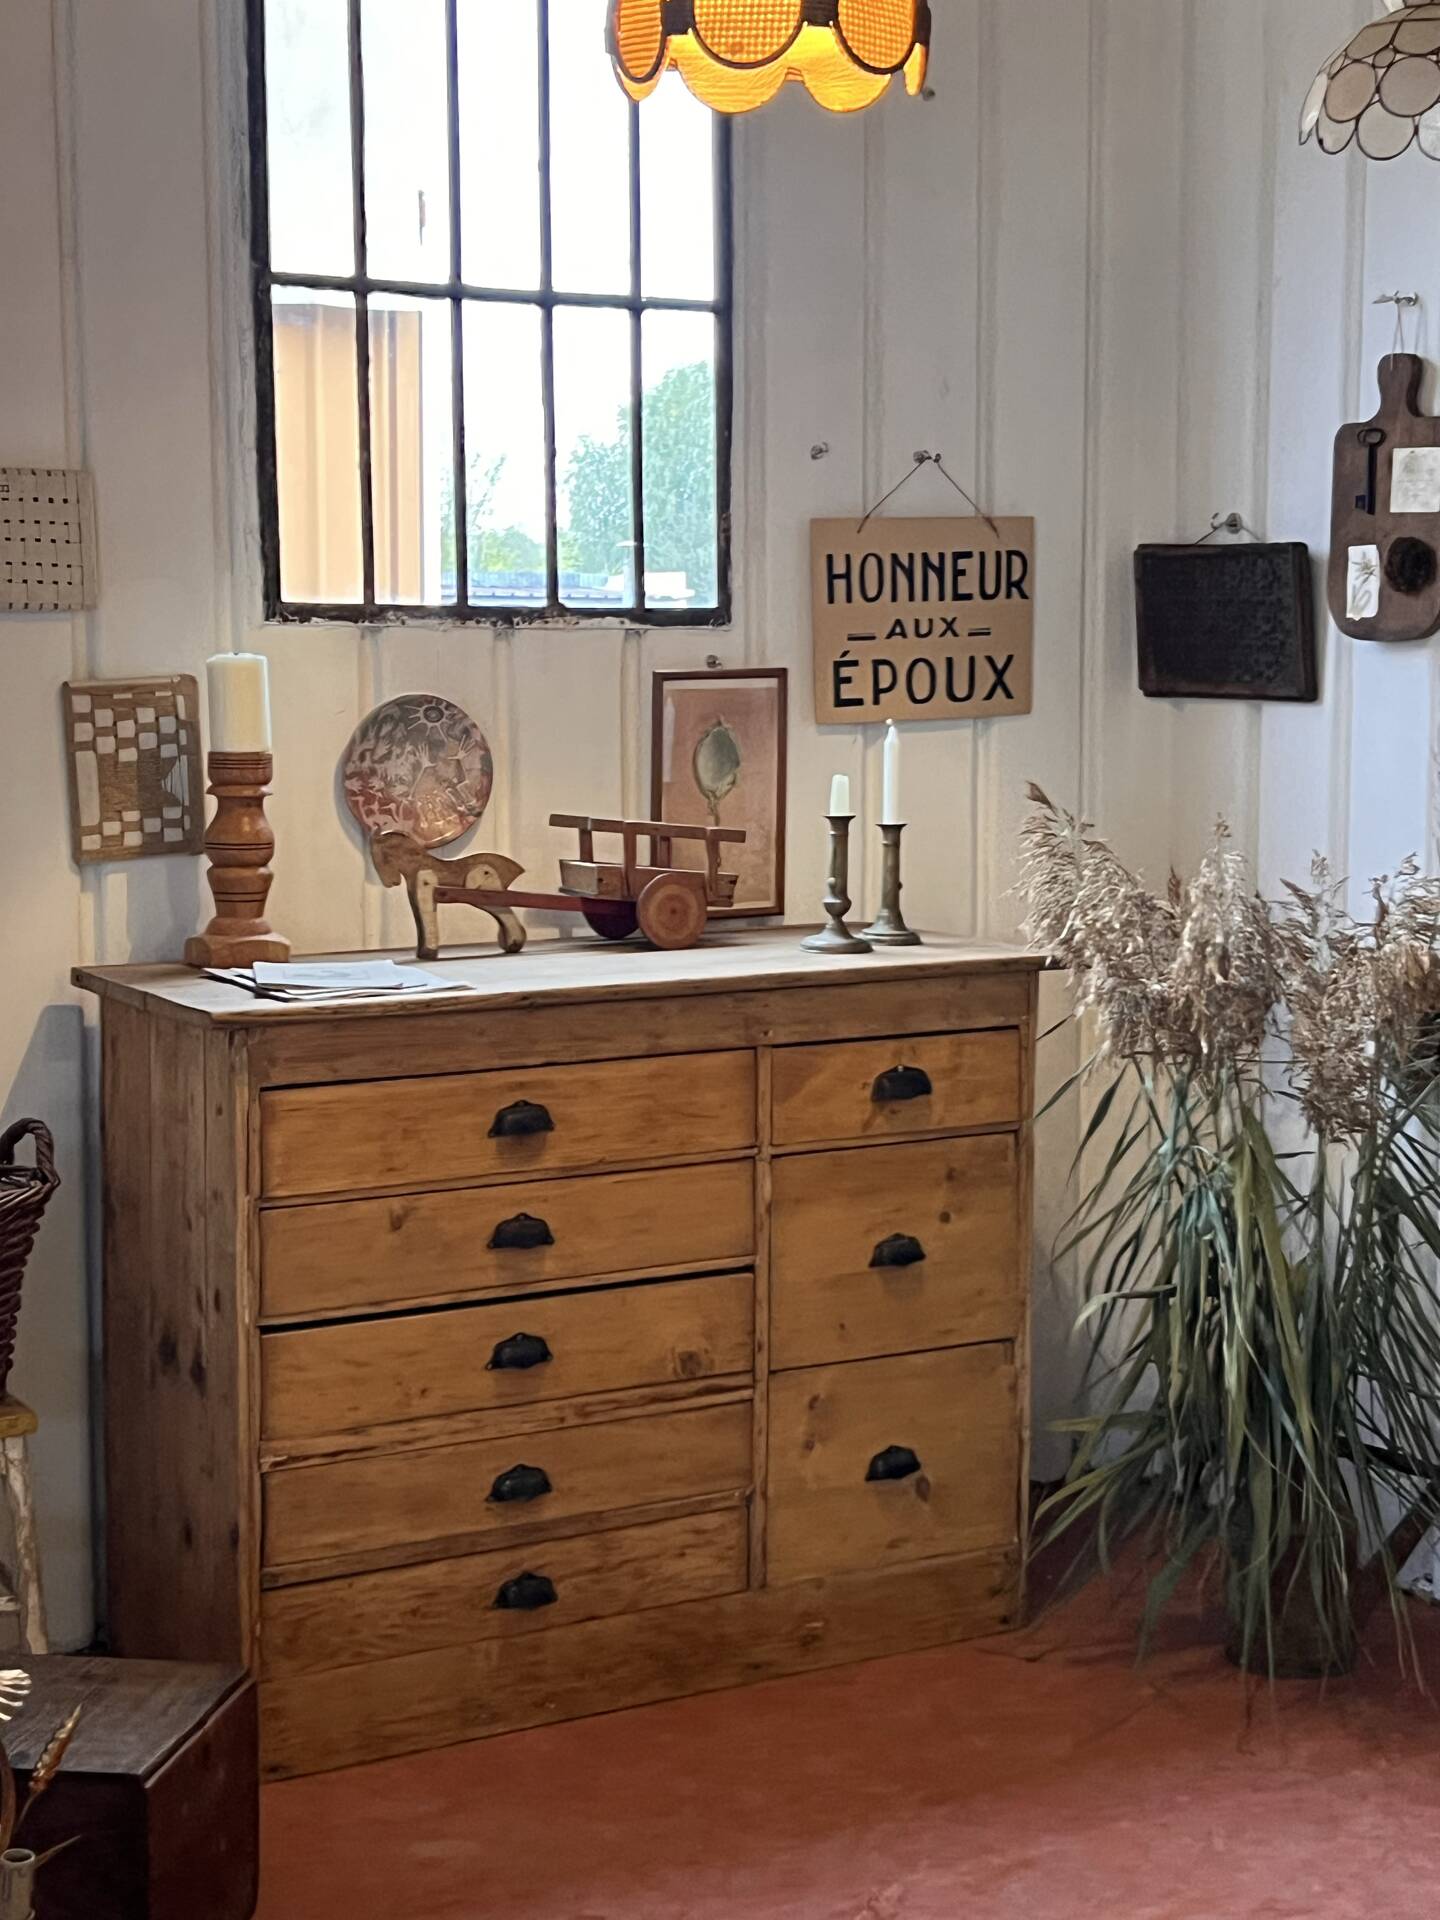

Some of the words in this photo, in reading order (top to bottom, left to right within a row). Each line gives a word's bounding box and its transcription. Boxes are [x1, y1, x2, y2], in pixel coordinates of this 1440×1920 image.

[826, 549, 1029, 604] HONNEUR
[885, 616, 960, 639] AUX
[833, 650, 1015, 708] ÉPOUX
